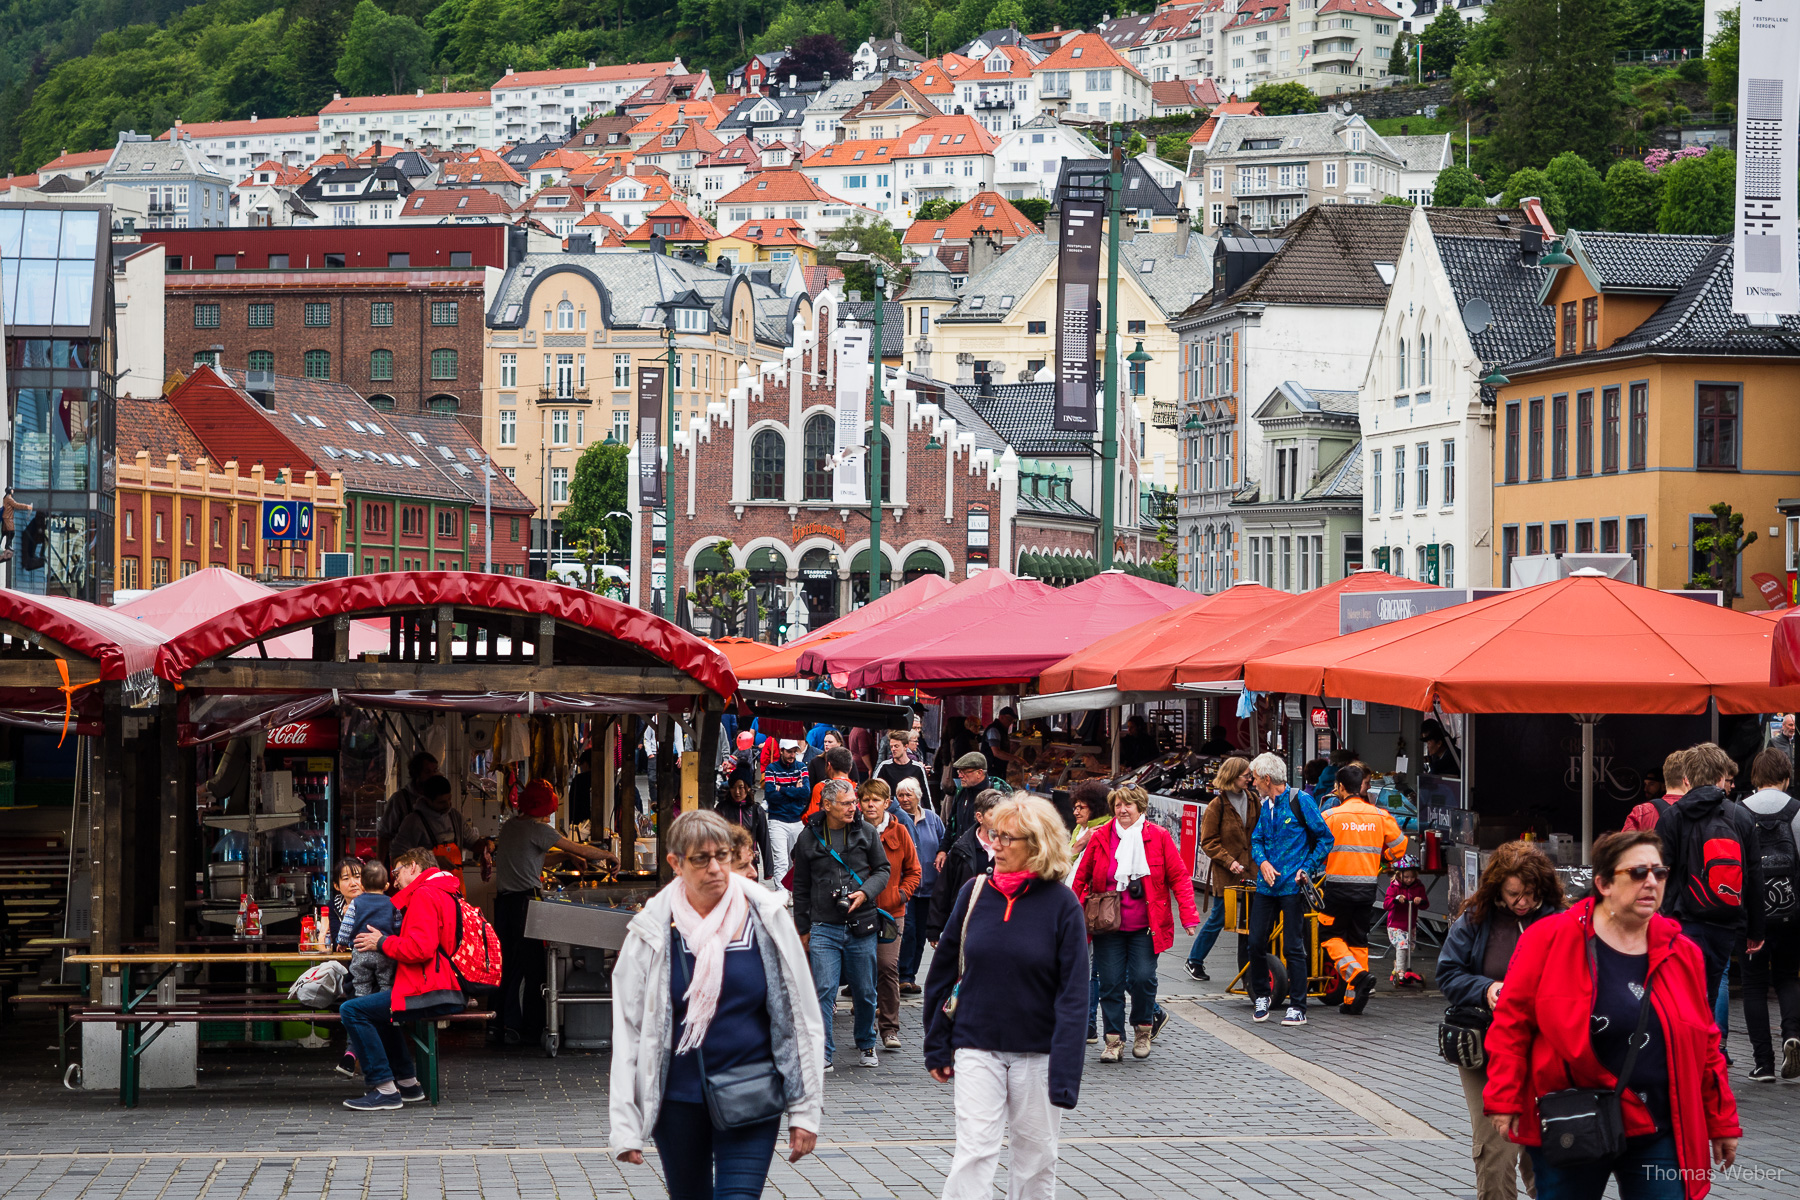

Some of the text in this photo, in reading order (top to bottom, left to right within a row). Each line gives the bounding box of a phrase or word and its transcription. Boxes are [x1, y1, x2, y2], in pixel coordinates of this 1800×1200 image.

[1746, 286, 1760, 296] DN
[273, 513, 286, 527] N
[301, 514, 309, 528] N
[1350, 821, 1376, 833] Bydrift
